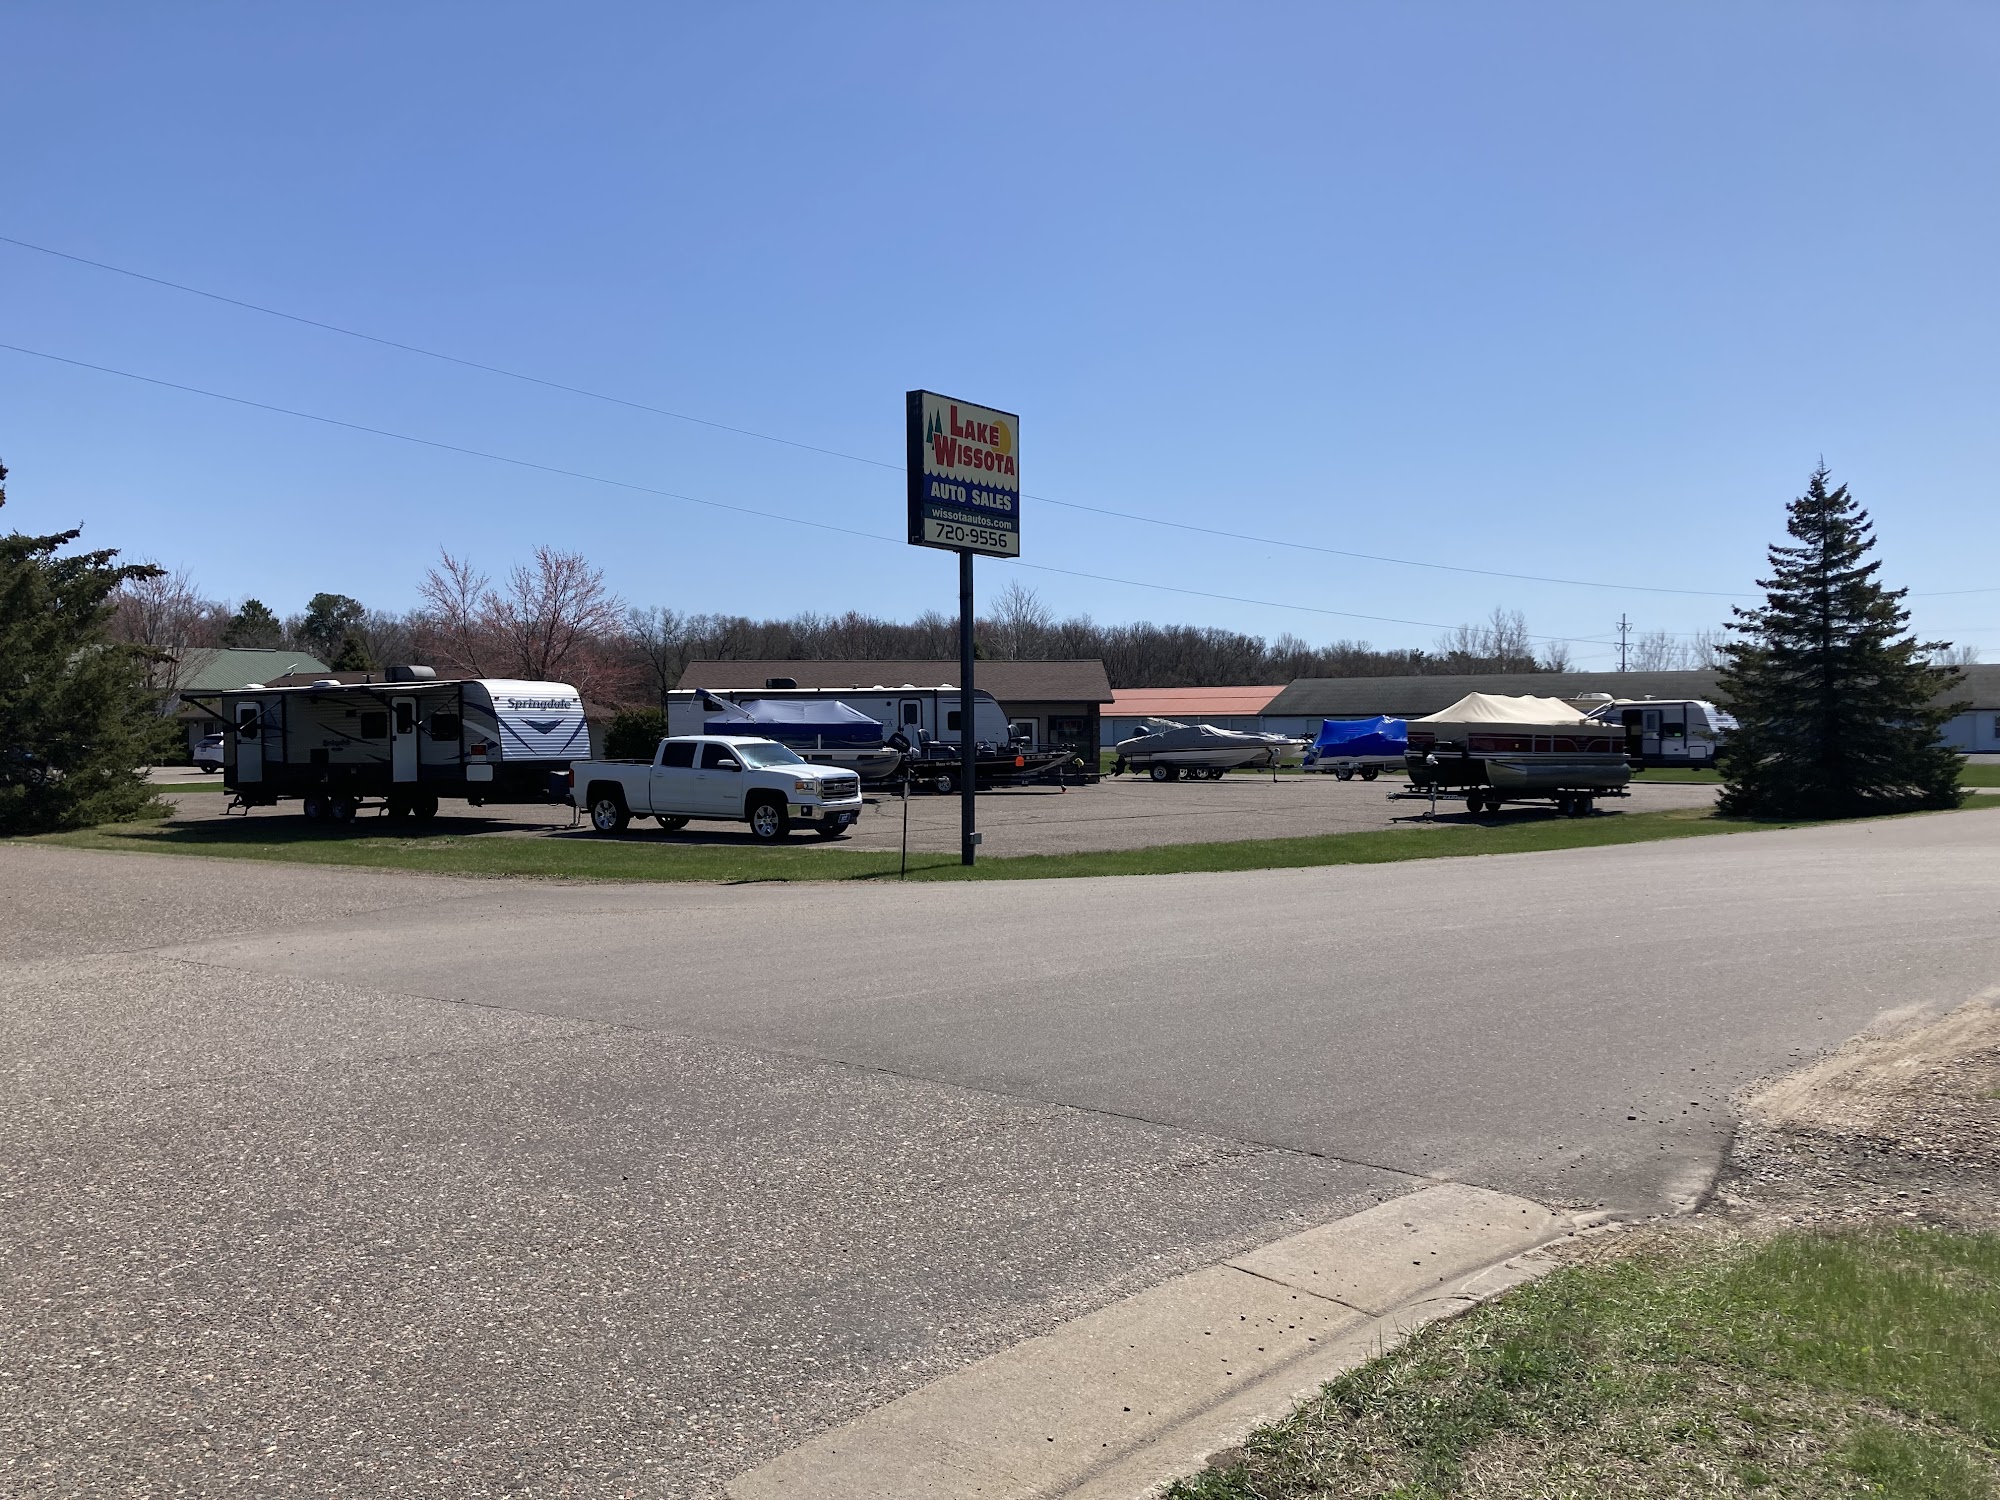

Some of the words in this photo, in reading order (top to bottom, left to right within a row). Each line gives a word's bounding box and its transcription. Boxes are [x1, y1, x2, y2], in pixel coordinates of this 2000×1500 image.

[950, 404, 999, 447] LAKE
[933, 433, 1015, 476] WISSOTA
[931, 481, 966, 503] AUTO
[972, 489, 1012, 511] SALES
[932, 508, 1012, 530] wissotaautos.com
[936, 523, 1008, 548] 720-9556
[507, 698, 572, 711] Springdale
